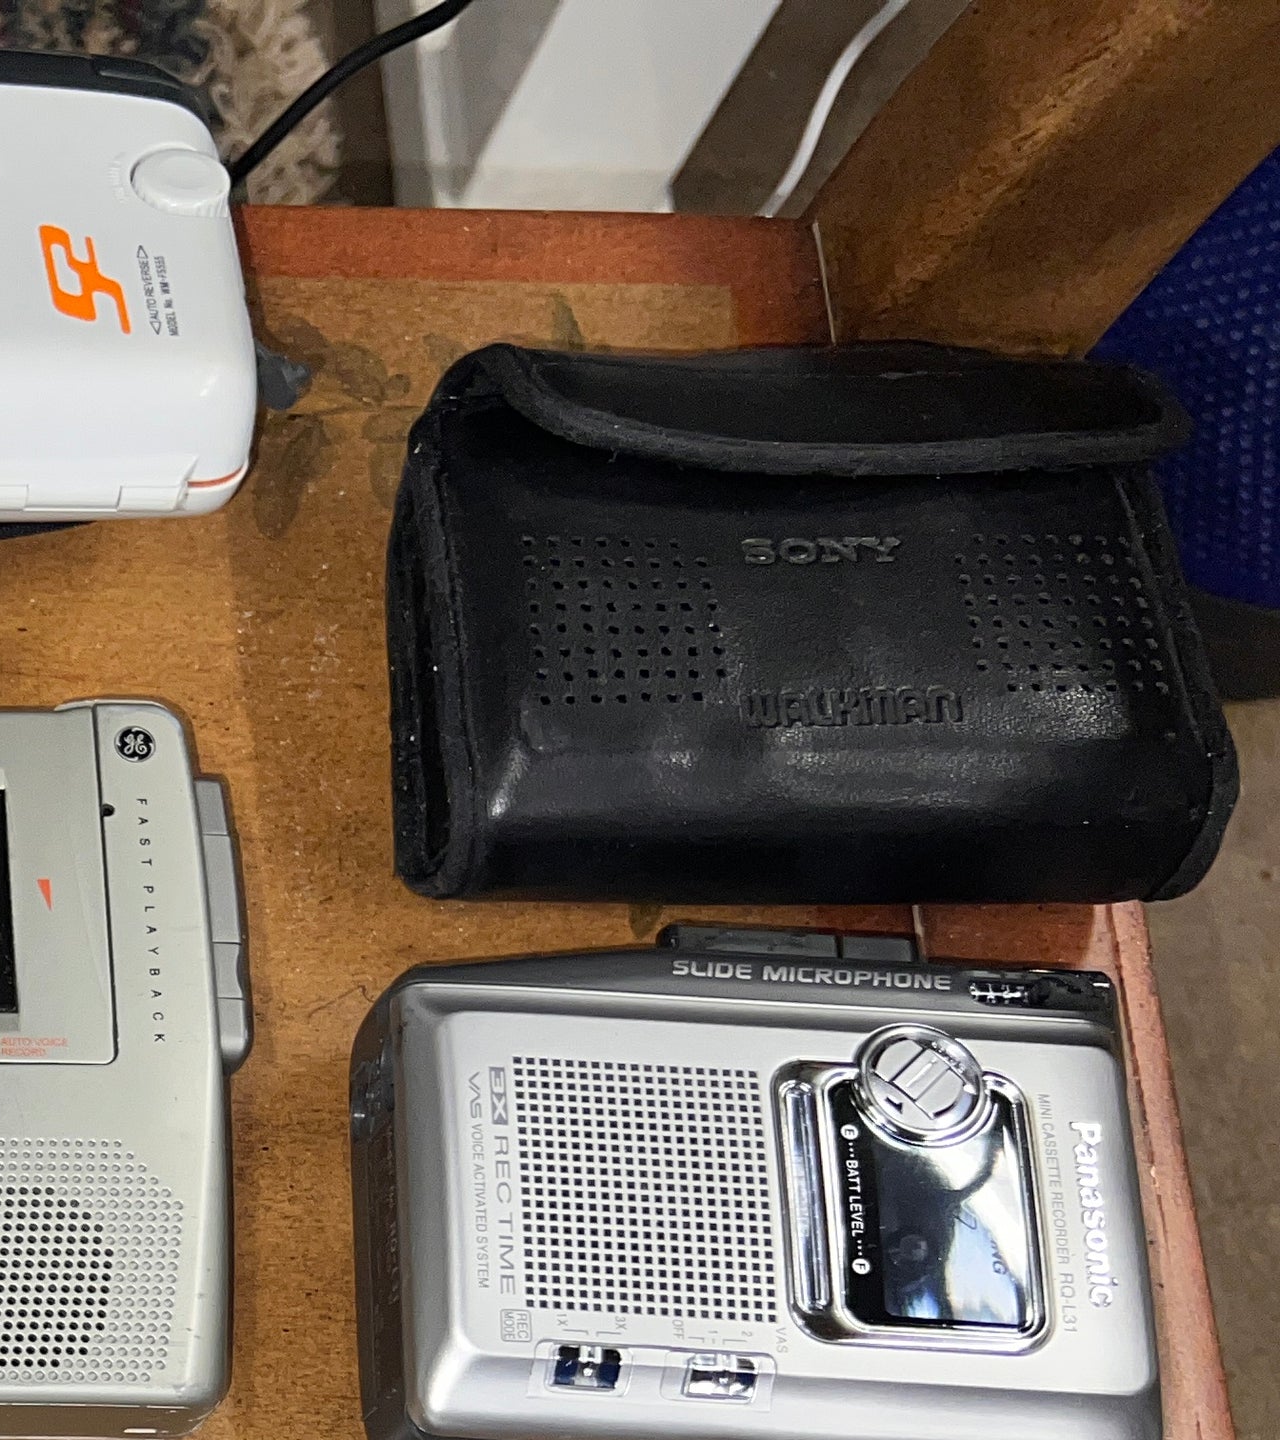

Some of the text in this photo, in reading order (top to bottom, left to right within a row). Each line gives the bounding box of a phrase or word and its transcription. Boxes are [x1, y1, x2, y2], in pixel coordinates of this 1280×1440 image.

[138, 260, 159, 320] AUTO REVERSE
[166, 312, 180, 337] MODEL
[741, 537, 901, 564] SONY
[747, 685, 964, 728] WALKMAN
[672, 960, 951, 991] SLIDE MICROPHONE
[468, 1071, 490, 1288] VAS VOICE ACTIVATED SYSTEM
[846, 1159, 864, 1237] BATT LEVEL
[494, 1136, 516, 1295] REC TIME
[1037, 1093, 1077, 1333] MINI CASSETTE RECORDER RQ-L31
[1069, 1121, 1119, 1308] Panasonic
[503, 1312, 515, 1339] MODE
[517, 1313, 528, 1339] REC
[672, 1319, 685, 1341] OFF
[774, 1327, 790, 1354] VAS
